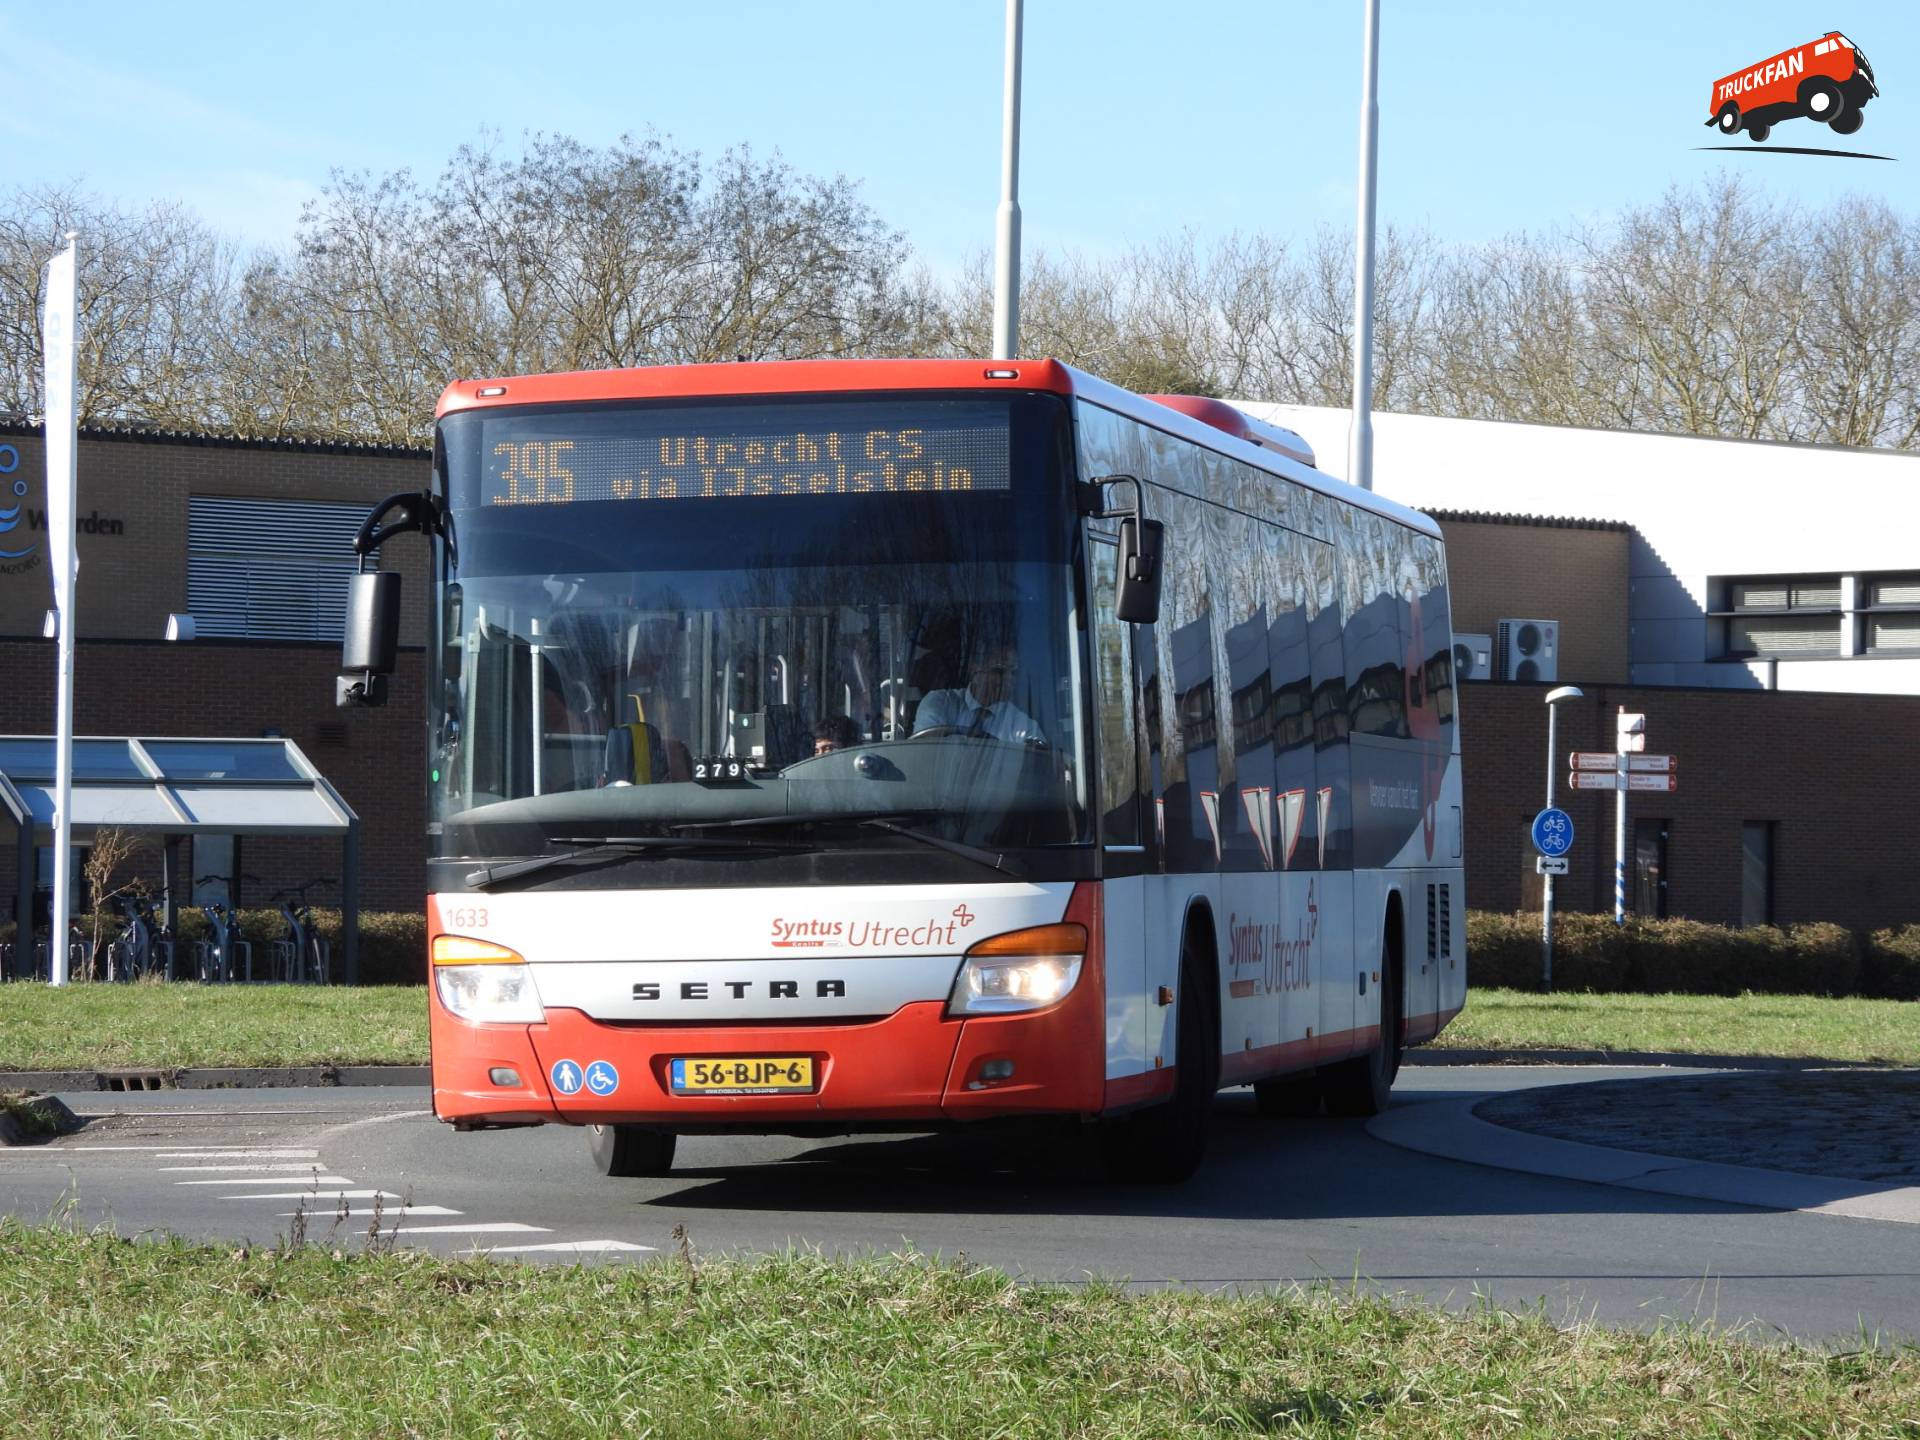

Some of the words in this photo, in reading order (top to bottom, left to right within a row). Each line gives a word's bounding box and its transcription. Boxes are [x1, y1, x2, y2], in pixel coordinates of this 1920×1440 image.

[659, 432, 842, 467] Utrecht
[865, 428, 923, 460] CS
[493, 440, 575, 506] 395
[611, 469, 679, 500] via
[700, 460, 973, 498] IJsselstein
[27, 508, 124, 536] Wrden
[695, 763, 740, 778] 279
[447, 908, 489, 928] 1633
[771, 917, 843, 942] Syntus
[848, 919, 957, 948] Utrecht
[1228, 911, 1263, 980] Syntus
[1264, 917, 1311, 995] Utrecht
[632, 979, 846, 1001] SETRA
[673, 1077, 685, 1085] NL
[693, 1062, 804, 1085] 56-BJP-6
